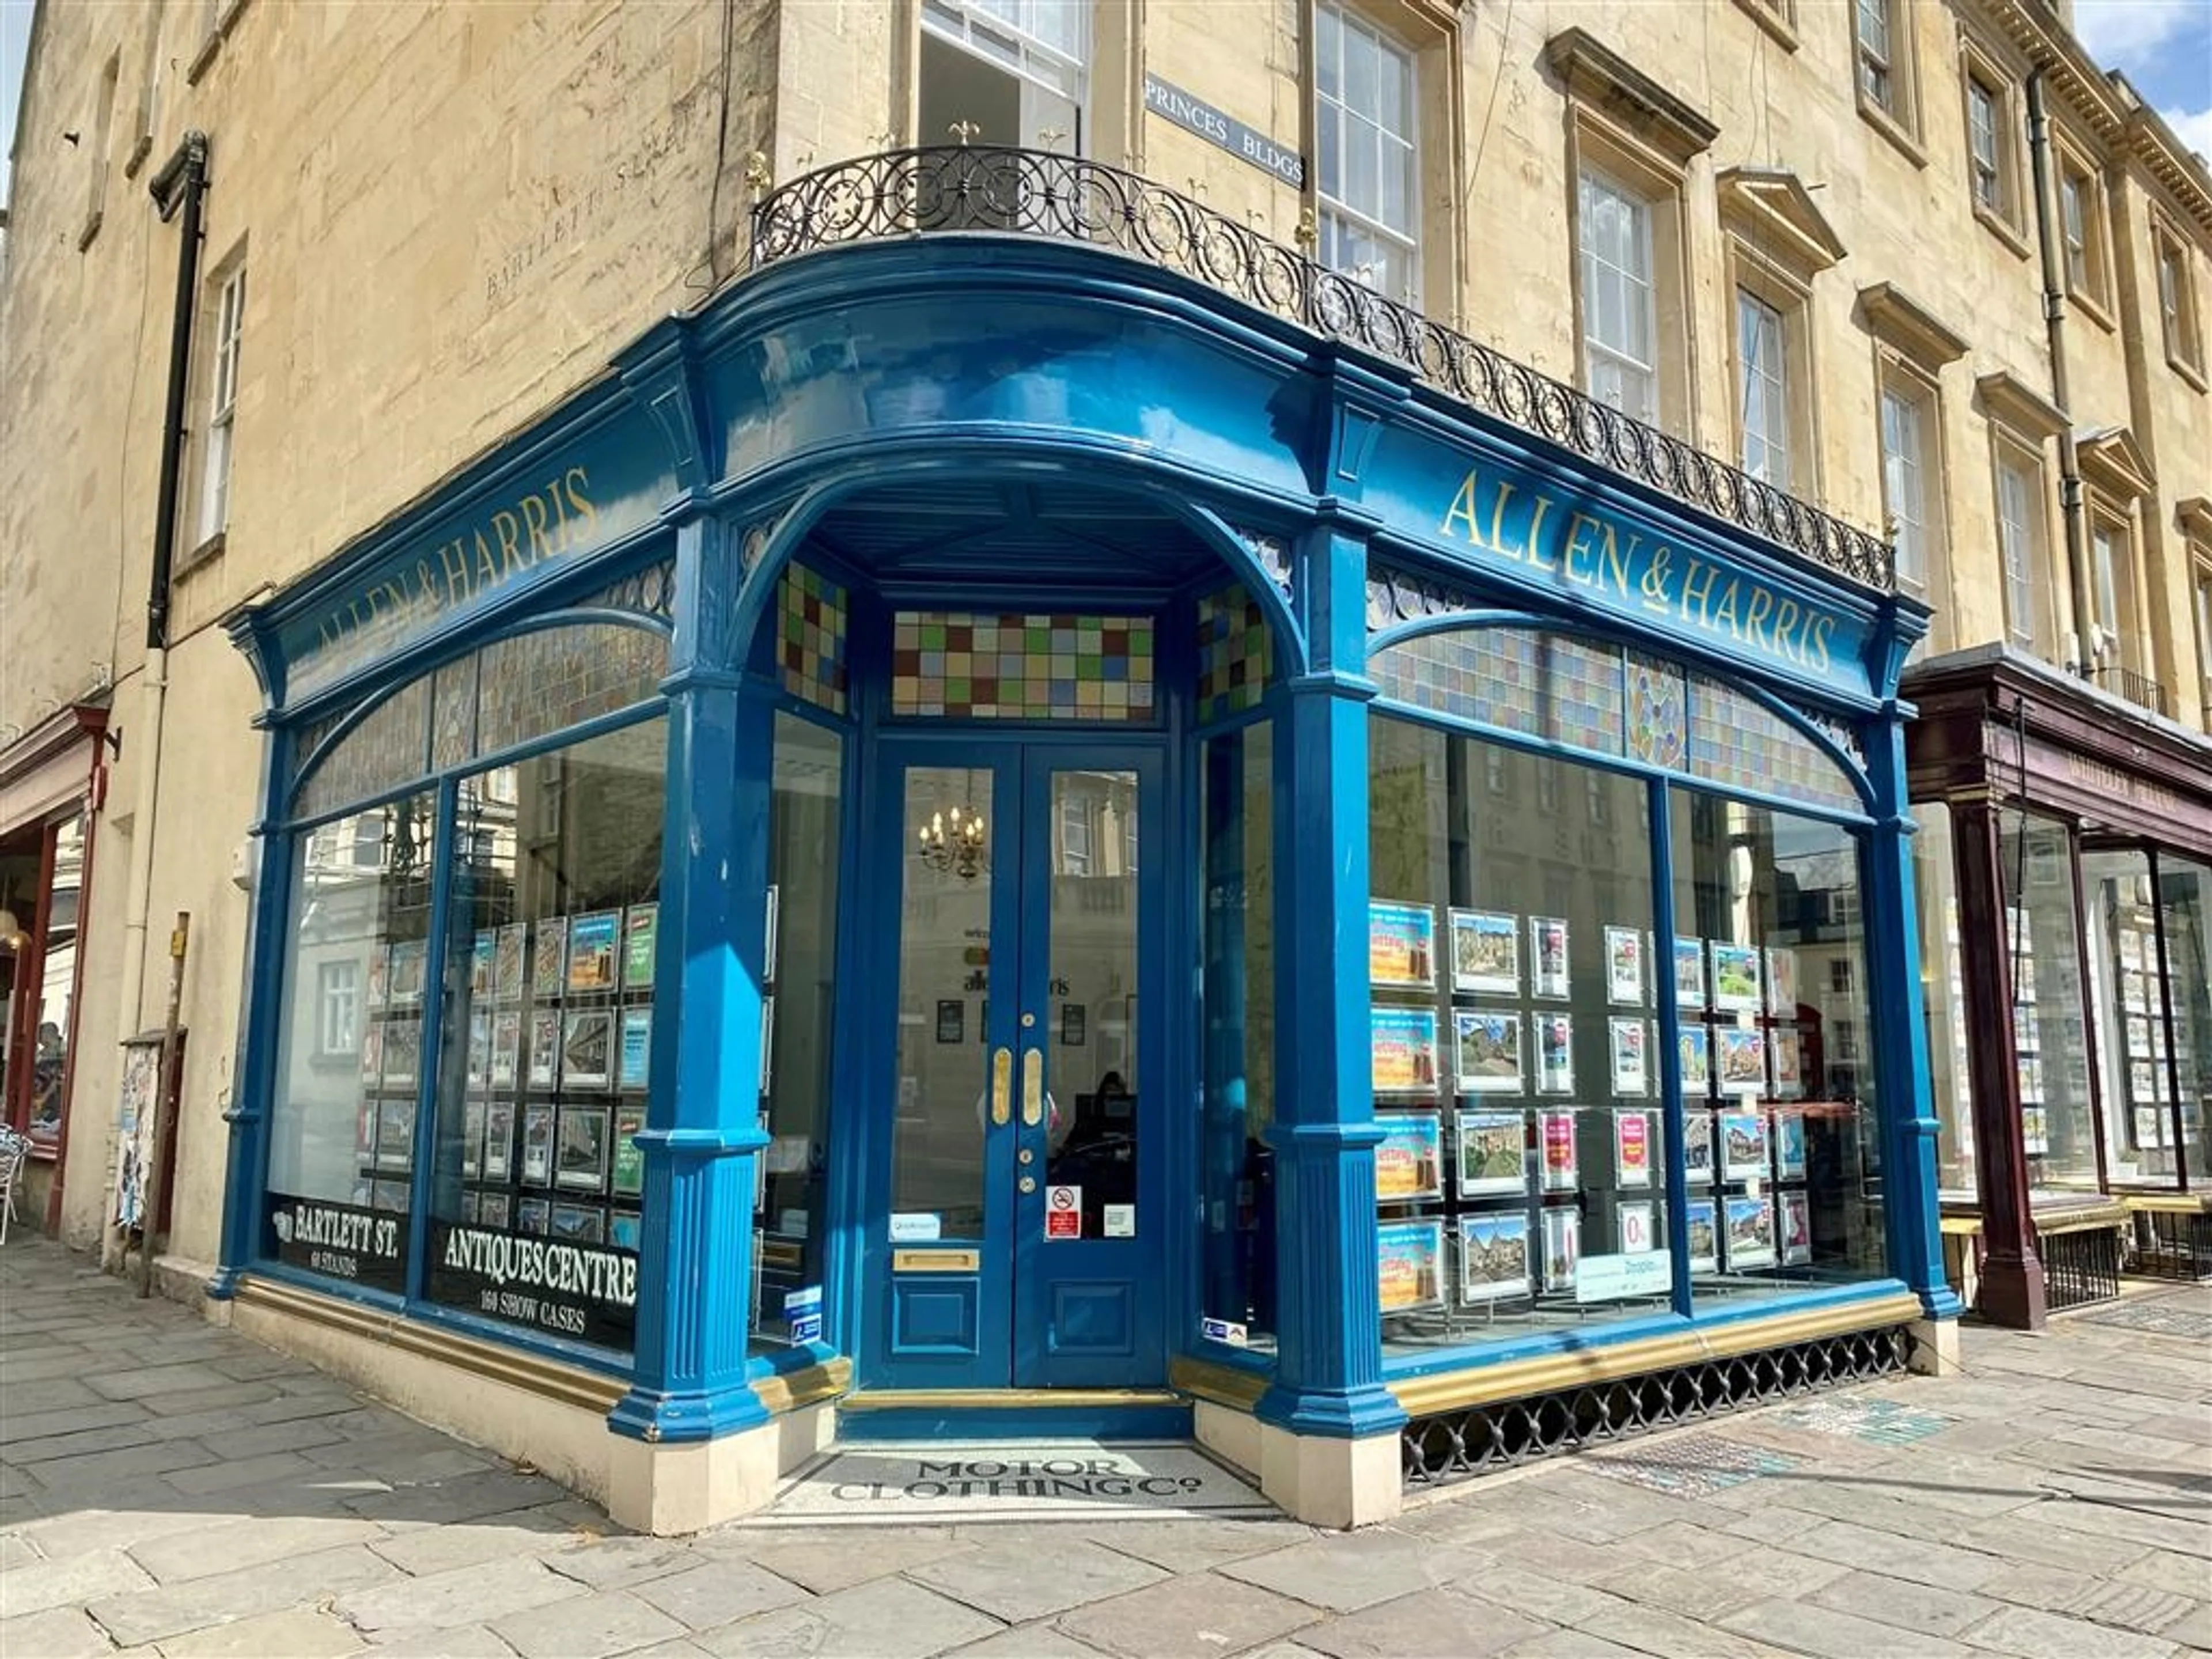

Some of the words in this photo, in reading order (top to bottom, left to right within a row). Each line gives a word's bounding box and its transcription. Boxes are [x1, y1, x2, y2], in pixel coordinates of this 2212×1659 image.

[1145, 78, 1228, 142] PRINCES
[1243, 133, 1303, 182] BLDGS
[317, 572, 415, 651] ALLEN
[416, 559, 445, 606] &
[437, 466, 598, 611] HARRIS
[1441, 468, 1642, 599] ALLEN
[1641, 546, 1672, 613] &
[1681, 559, 1835, 673] HARRIS
[296, 1205, 372, 1252] BARTLETT
[376, 1219, 398, 1259] ST.
[321, 1251, 358, 1277] STANDS
[499, 1291, 538, 1321] SHOW
[540, 1302, 585, 1334] CASES
[831, 1478, 1132, 1500] CLOTHING
[920, 1459, 1123, 1478] MOTOR
